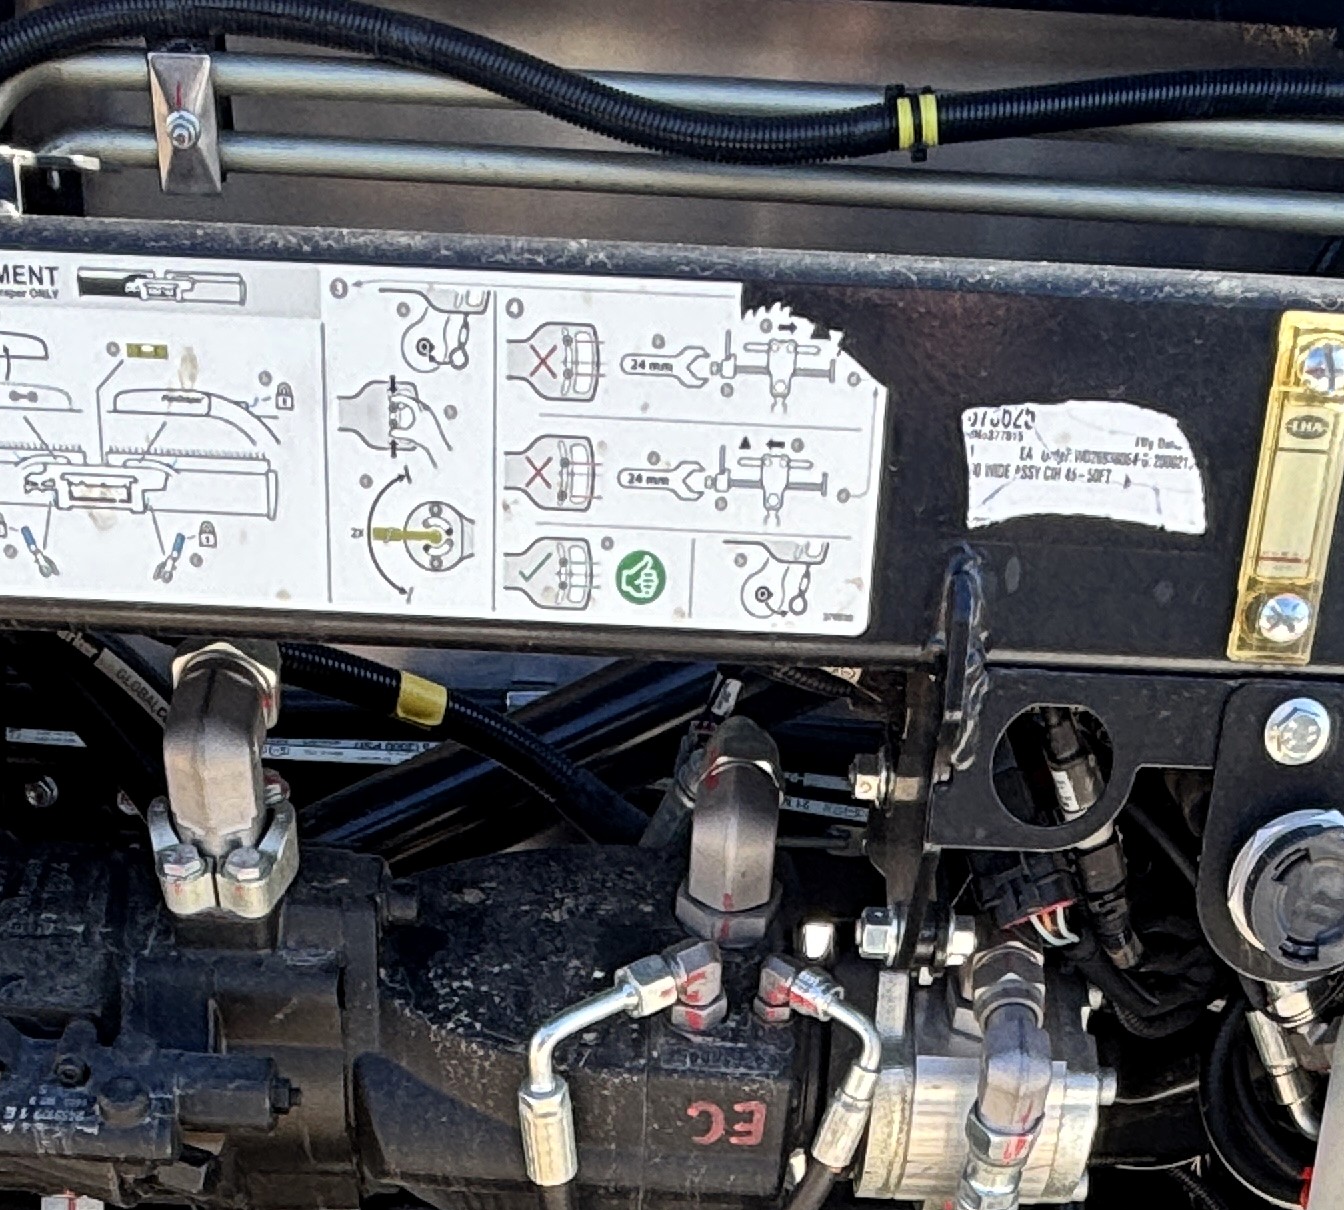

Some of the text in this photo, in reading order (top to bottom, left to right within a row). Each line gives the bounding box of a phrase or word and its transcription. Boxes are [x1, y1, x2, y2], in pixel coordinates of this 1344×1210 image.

[29, 287, 60, 300] ONLY
[630, 358, 646, 370] 24
[686, 1100, 768, 1146] EC
